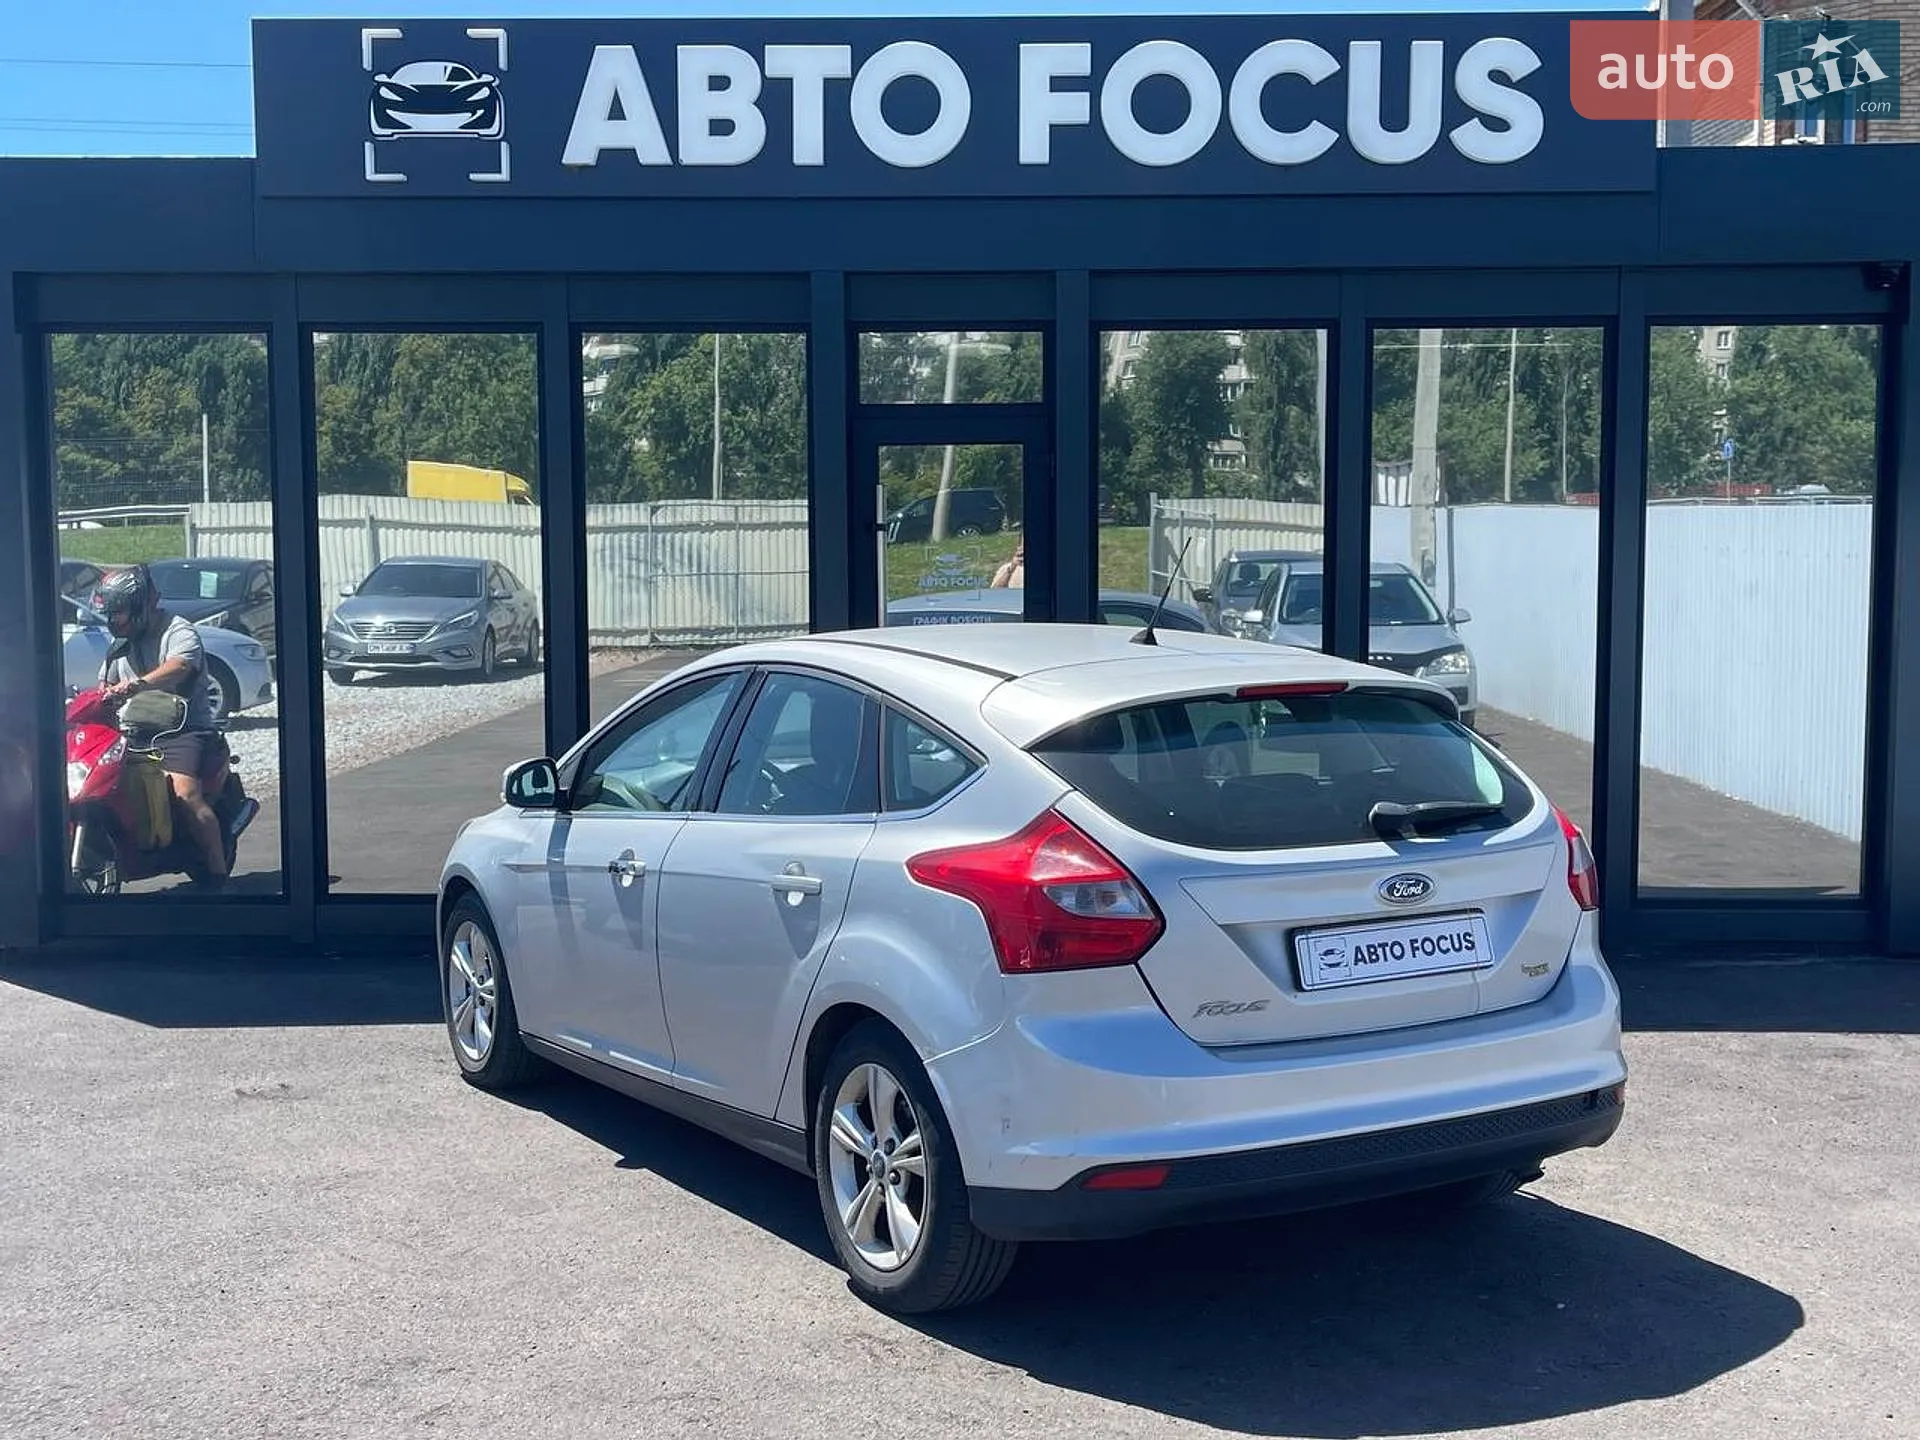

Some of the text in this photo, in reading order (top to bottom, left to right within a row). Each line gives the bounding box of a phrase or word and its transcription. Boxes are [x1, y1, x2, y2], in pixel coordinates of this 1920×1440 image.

[562, 37, 1544, 167] АВТО FOCUS
[1393, 879, 1424, 897] Ford
[1353, 931, 1477, 967] АВТО FOCUS
